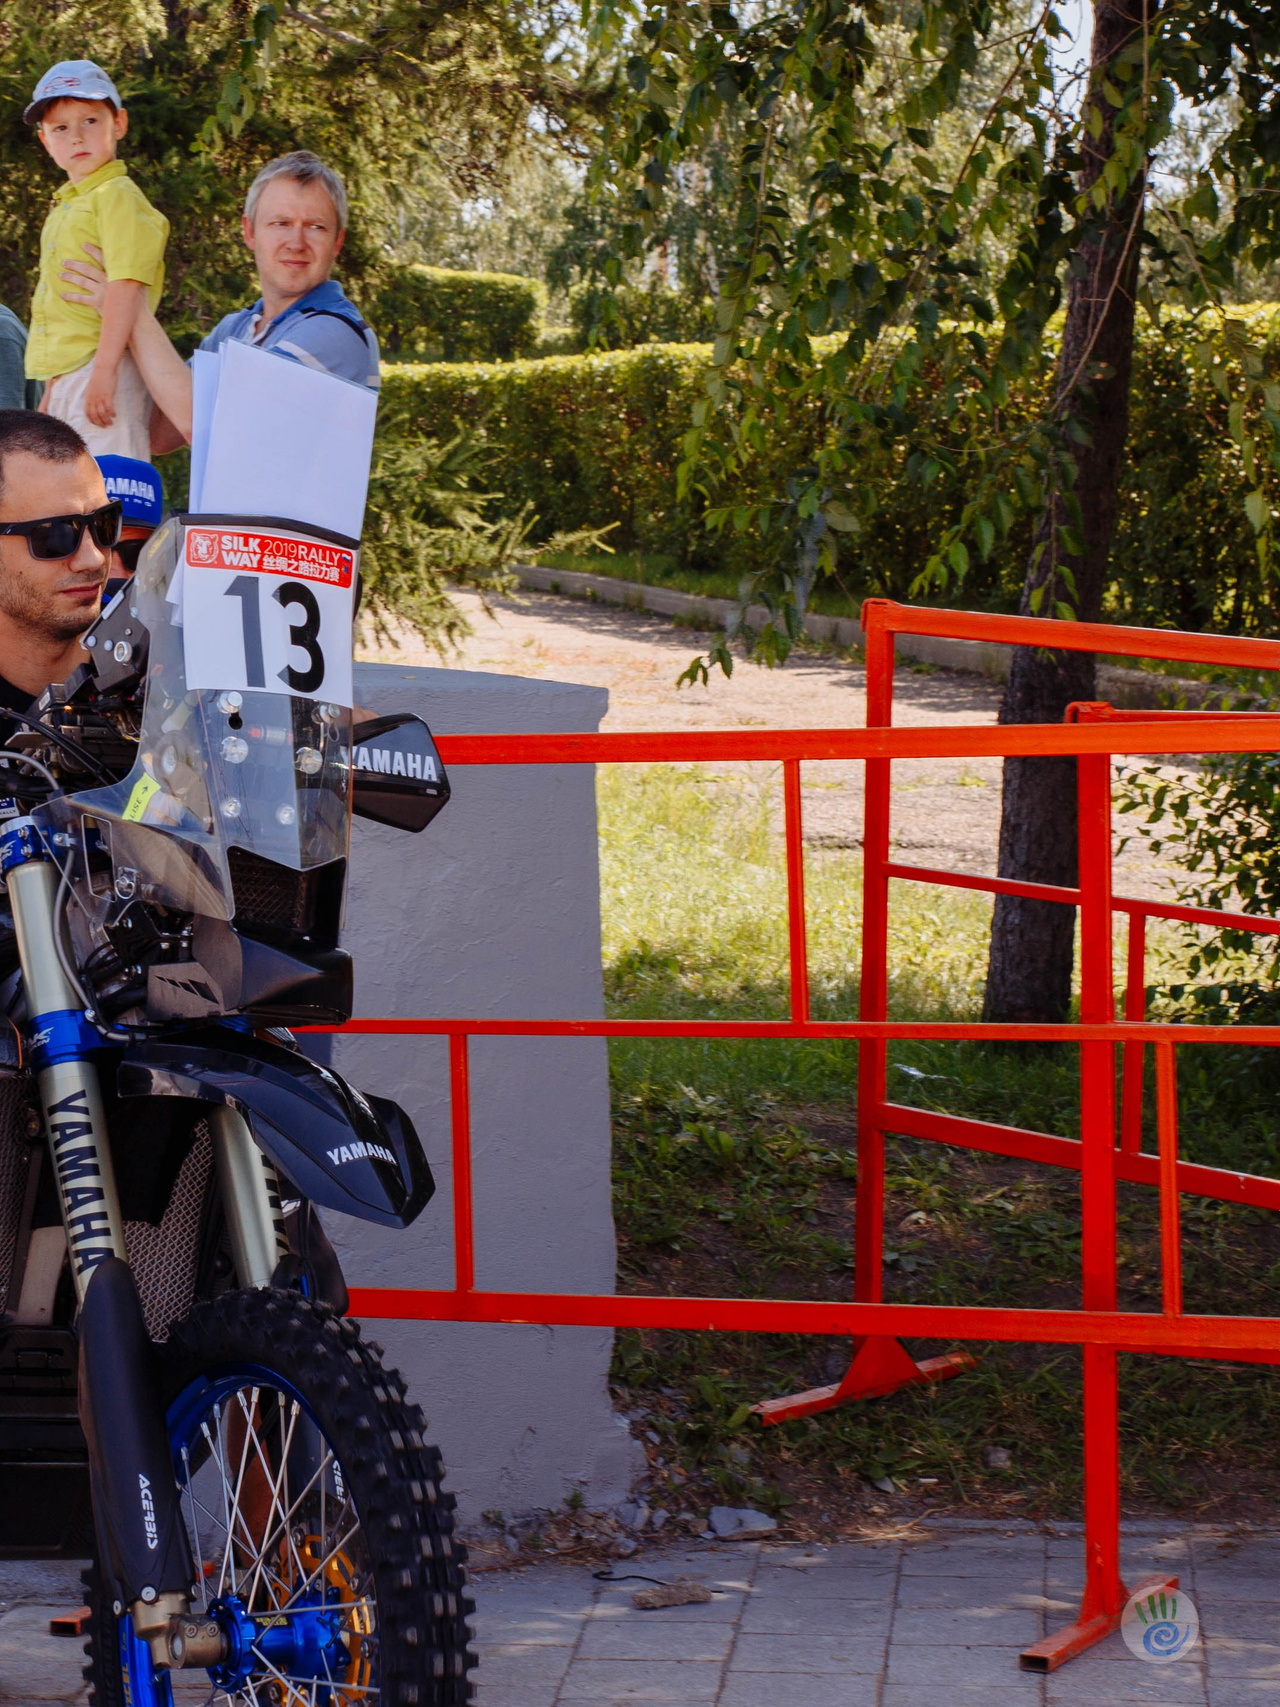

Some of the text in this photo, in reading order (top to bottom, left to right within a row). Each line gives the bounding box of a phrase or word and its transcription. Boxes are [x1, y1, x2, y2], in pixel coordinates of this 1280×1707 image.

[103, 477, 156, 502] AMAHA
[221, 534, 341, 566] SILK 2019 RALLY
[222, 550, 261, 568] WAY
[262, 555, 340, 583] 丝绸之路拉力赛
[223, 575, 326, 693] 13
[340, 746, 438, 782] YAMAHA
[326, 1141, 398, 1167] YAMAHA
[47, 1088, 117, 1275] YAMAHA
